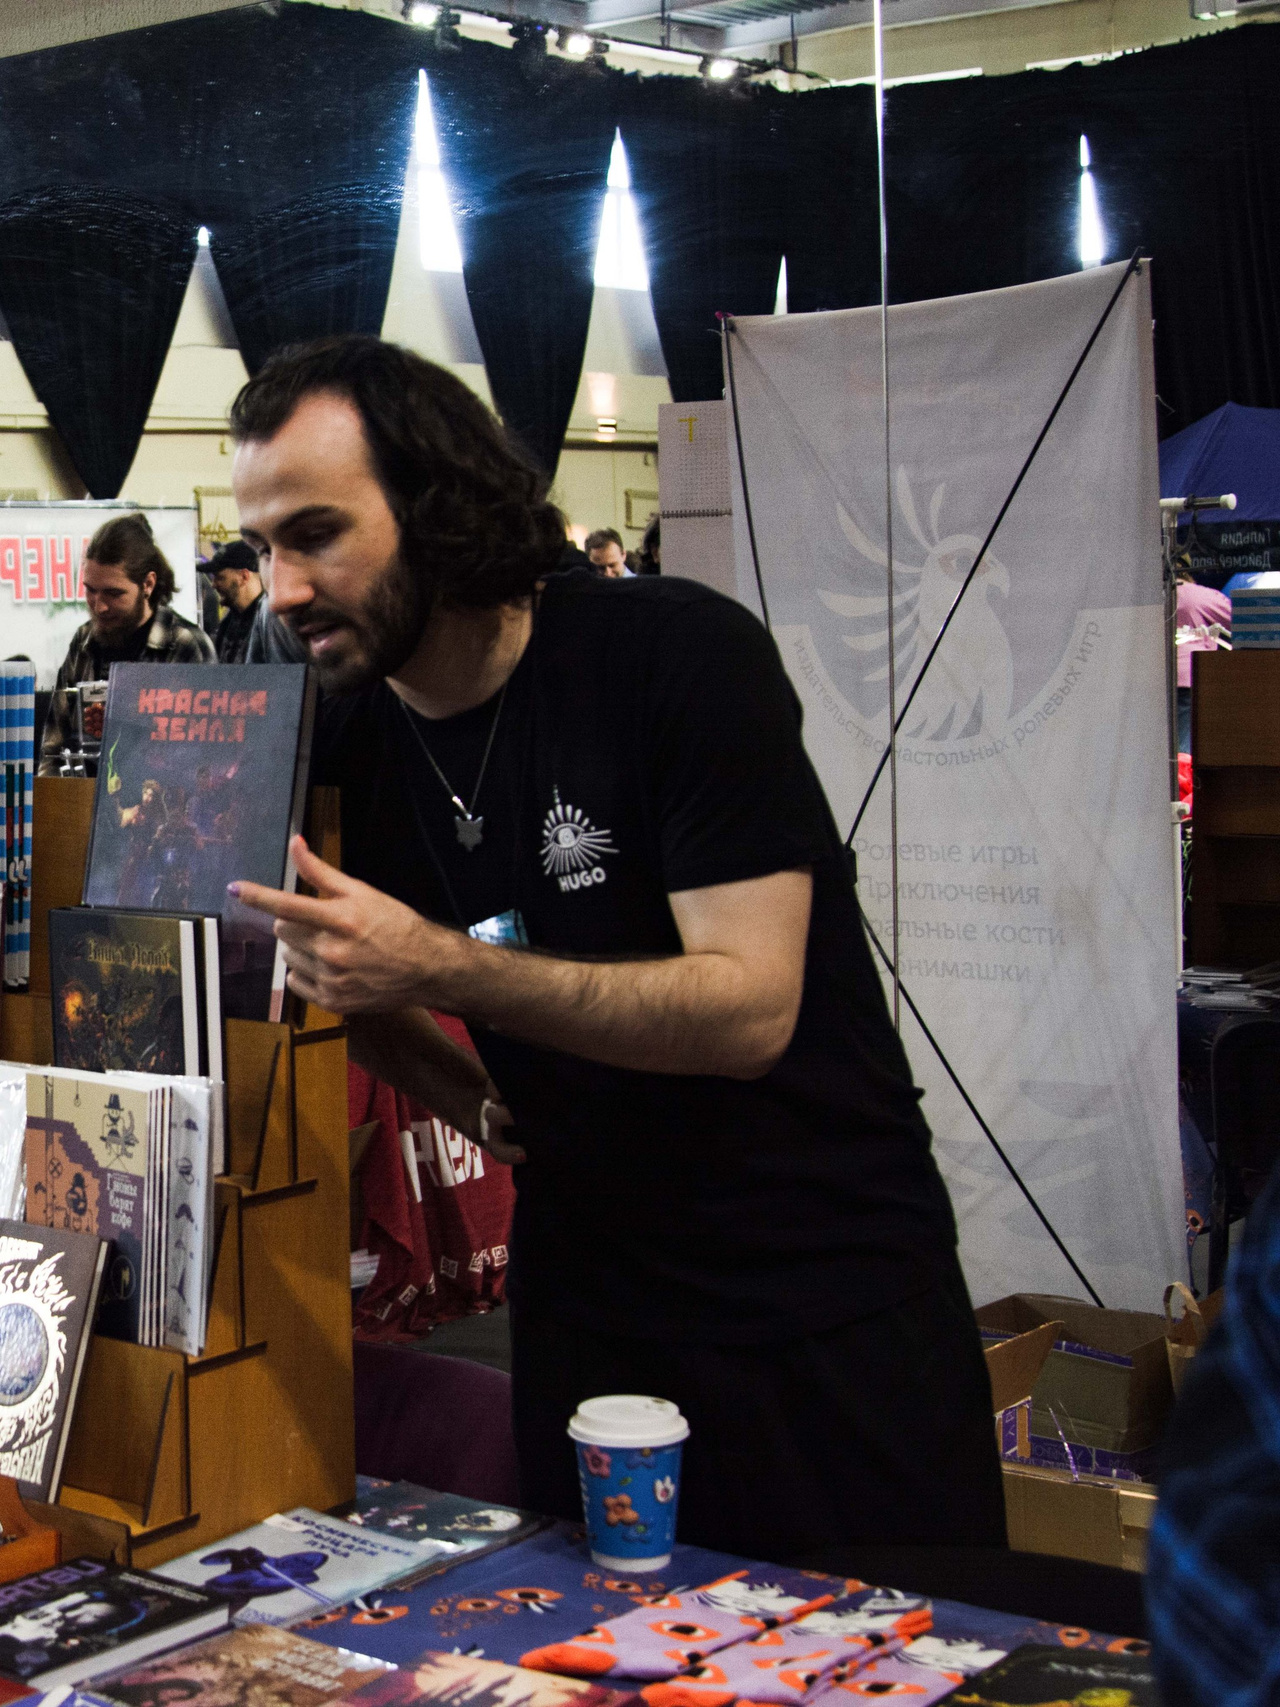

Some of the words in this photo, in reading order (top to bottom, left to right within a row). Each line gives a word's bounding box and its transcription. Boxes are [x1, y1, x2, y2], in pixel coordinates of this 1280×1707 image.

[1016, 666, 1082, 743] ролевых
[1075, 620, 1103, 664] игр
[557, 866, 607, 892] HUGO
